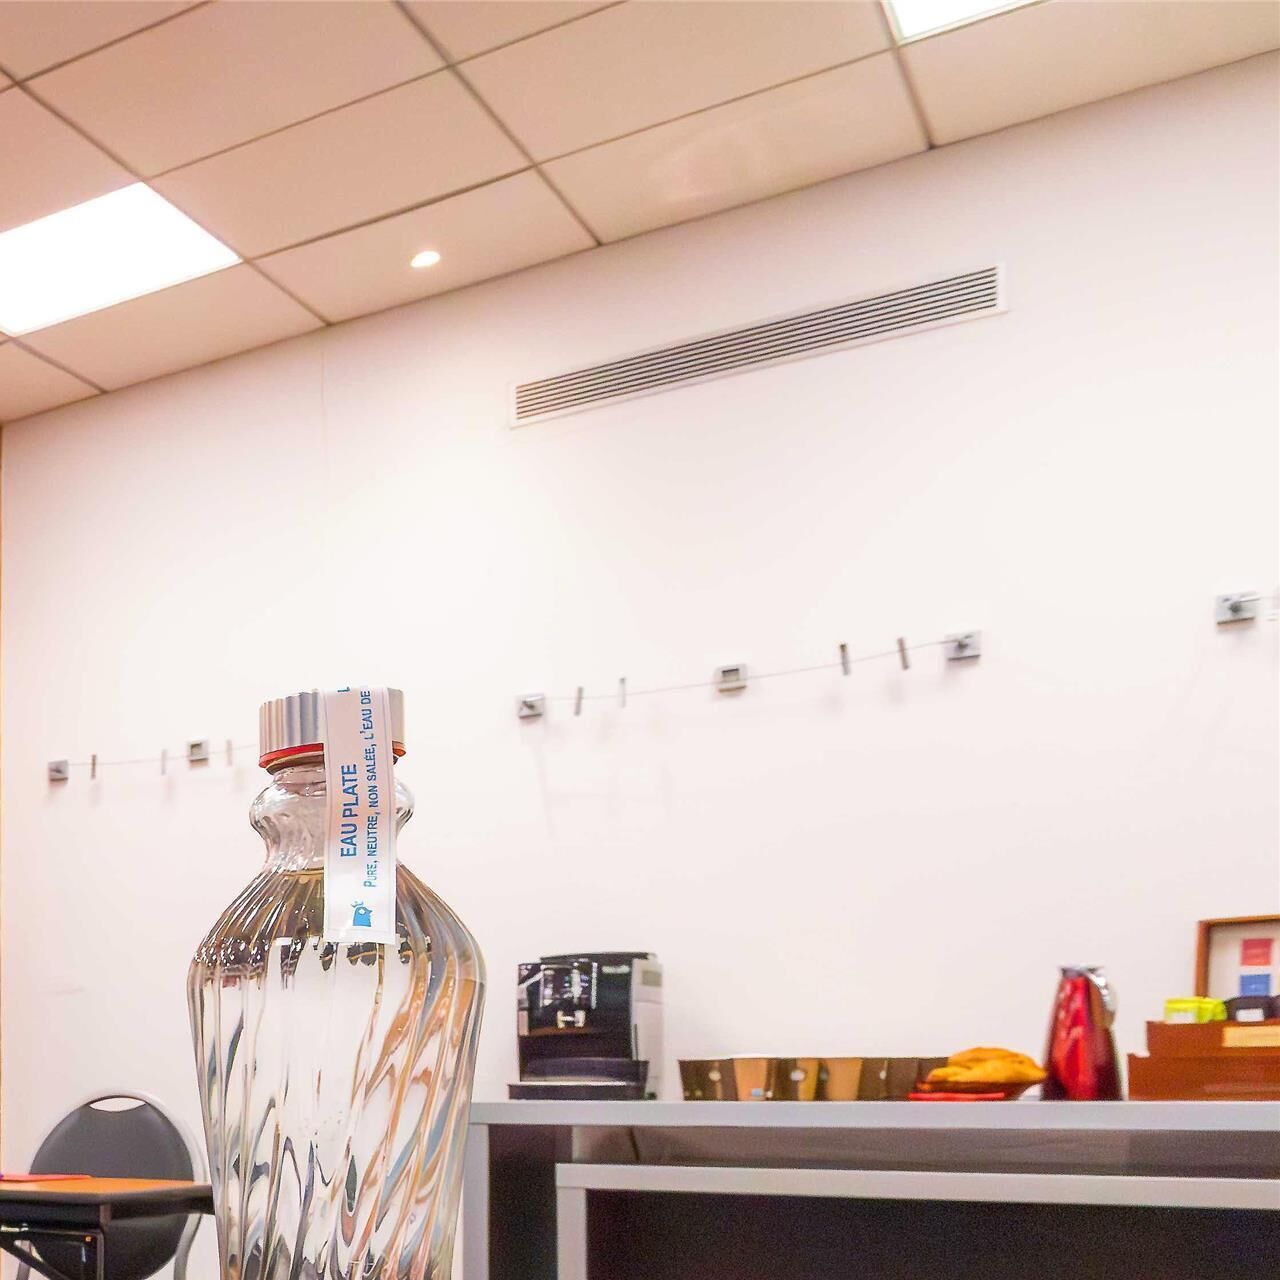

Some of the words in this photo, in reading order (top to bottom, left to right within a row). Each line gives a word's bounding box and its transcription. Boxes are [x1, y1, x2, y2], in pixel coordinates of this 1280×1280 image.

[360, 690, 371, 705] DE
[360, 709, 375, 740] L'EAU
[341, 763, 358, 818] PLATE
[368, 785, 378, 808] NON
[340, 824, 357, 857] EAU
